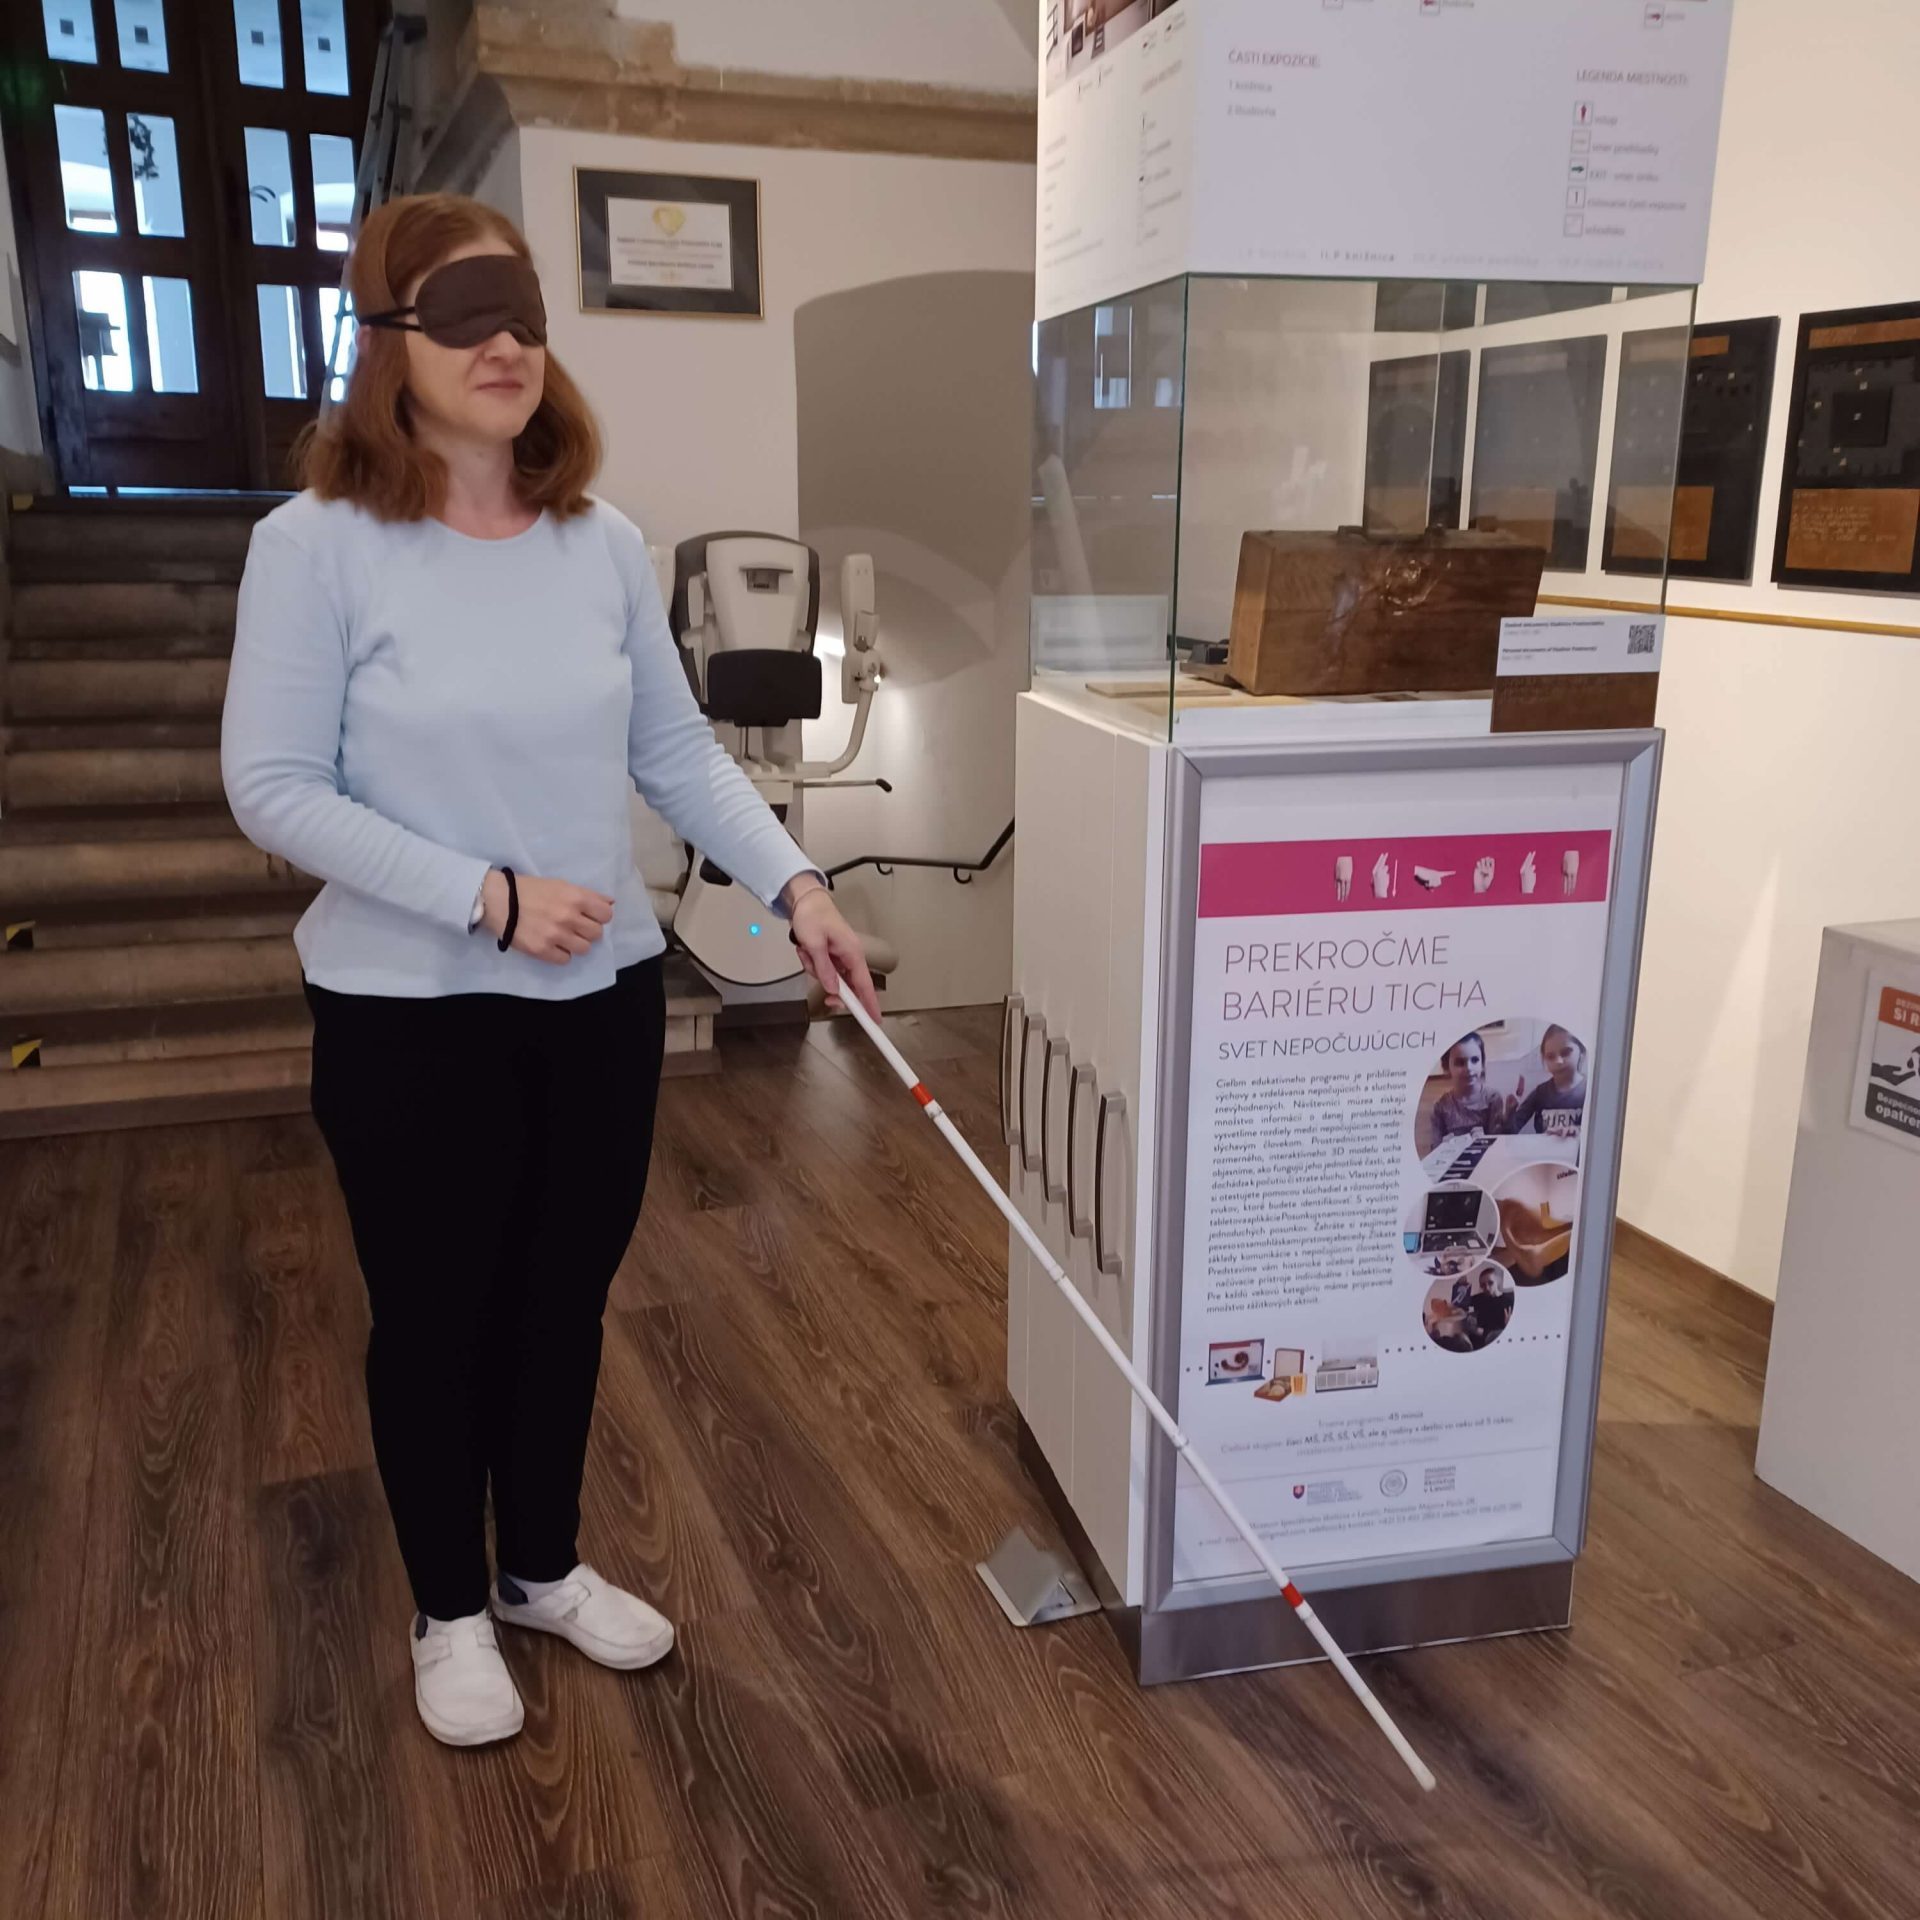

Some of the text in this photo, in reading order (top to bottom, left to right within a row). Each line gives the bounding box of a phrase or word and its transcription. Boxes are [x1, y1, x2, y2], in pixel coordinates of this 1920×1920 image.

[1225, 931, 1450, 974] PREKROČME
[1223, 980, 1487, 1021] BARIÉRU TICHA
[1218, 1031, 1436, 1060] SVET NEPOČUJÚCICH
[1257, 1164, 1272, 1174] ako
